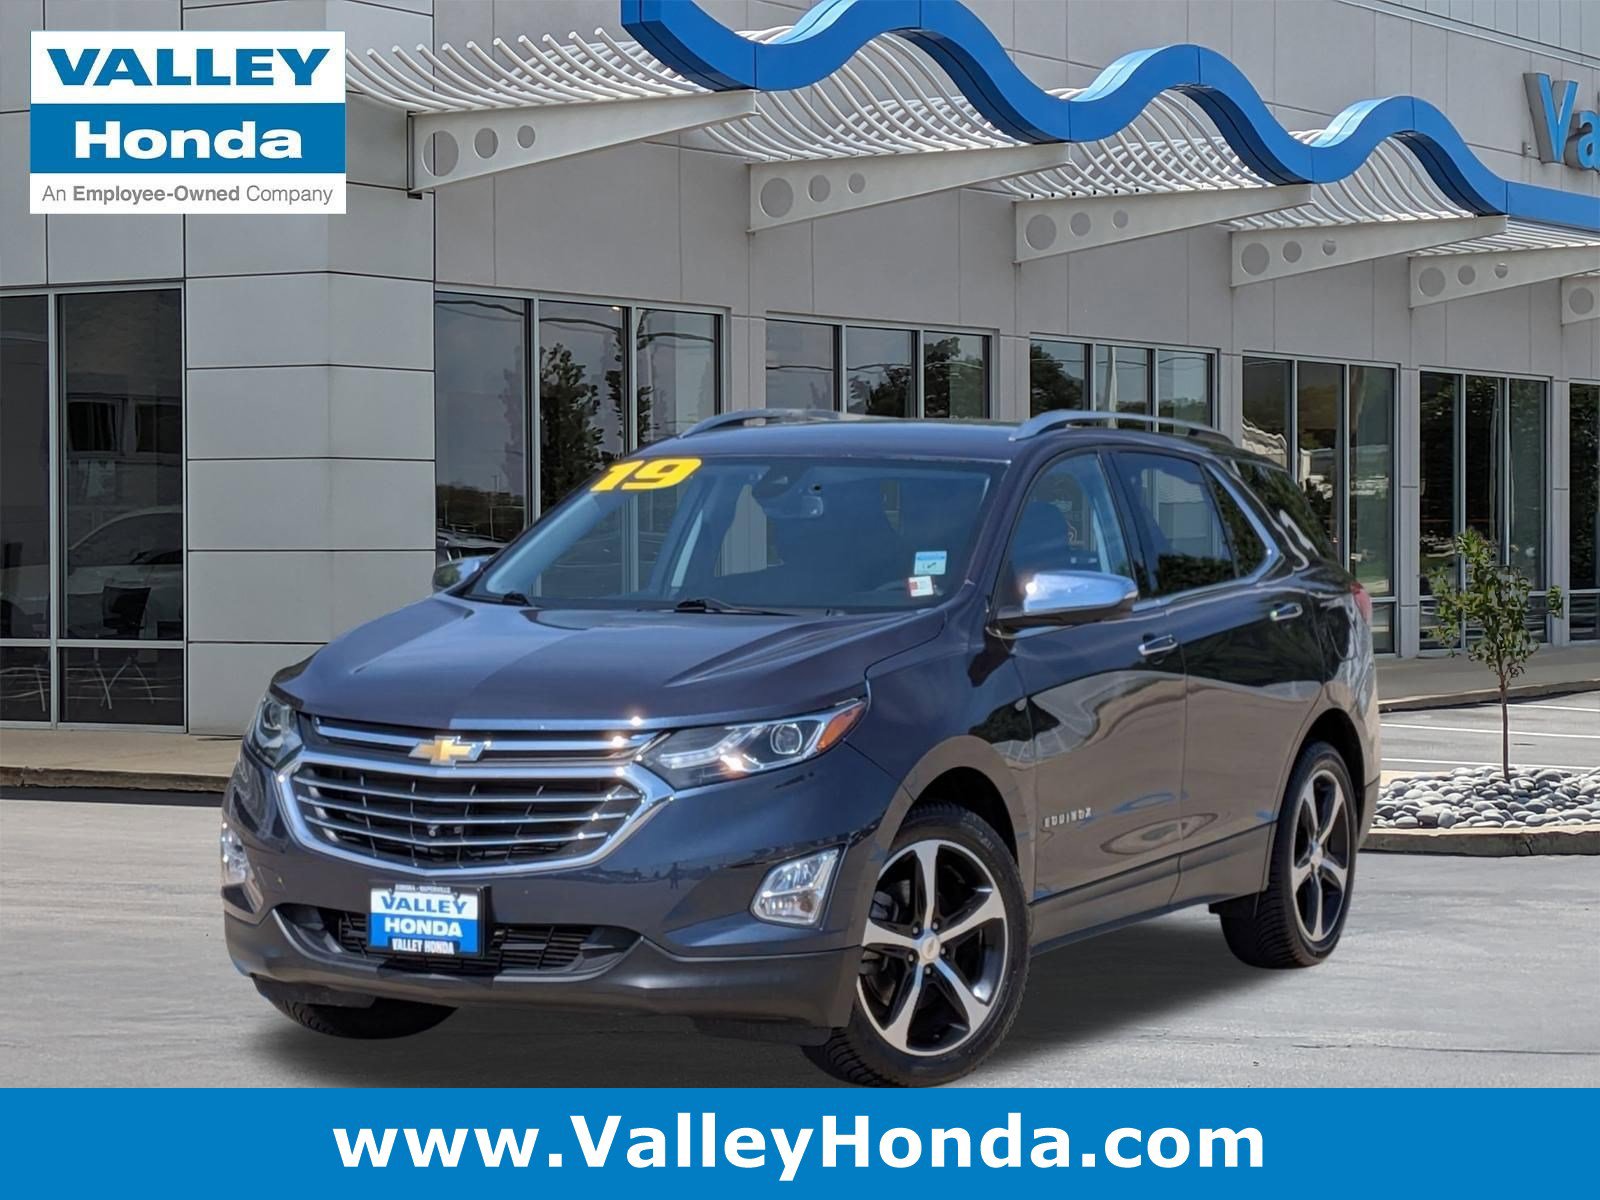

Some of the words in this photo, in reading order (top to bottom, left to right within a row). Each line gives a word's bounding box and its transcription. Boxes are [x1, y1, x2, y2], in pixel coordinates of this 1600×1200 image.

[1523, 72, 1600, 171] Va
[590, 458, 702, 491] 19
[381, 896, 467, 915] VALLEY
[384, 916, 464, 938] HONDA
[391, 938, 423, 953] VALLEY
[424, 939, 455, 955] HONDA
